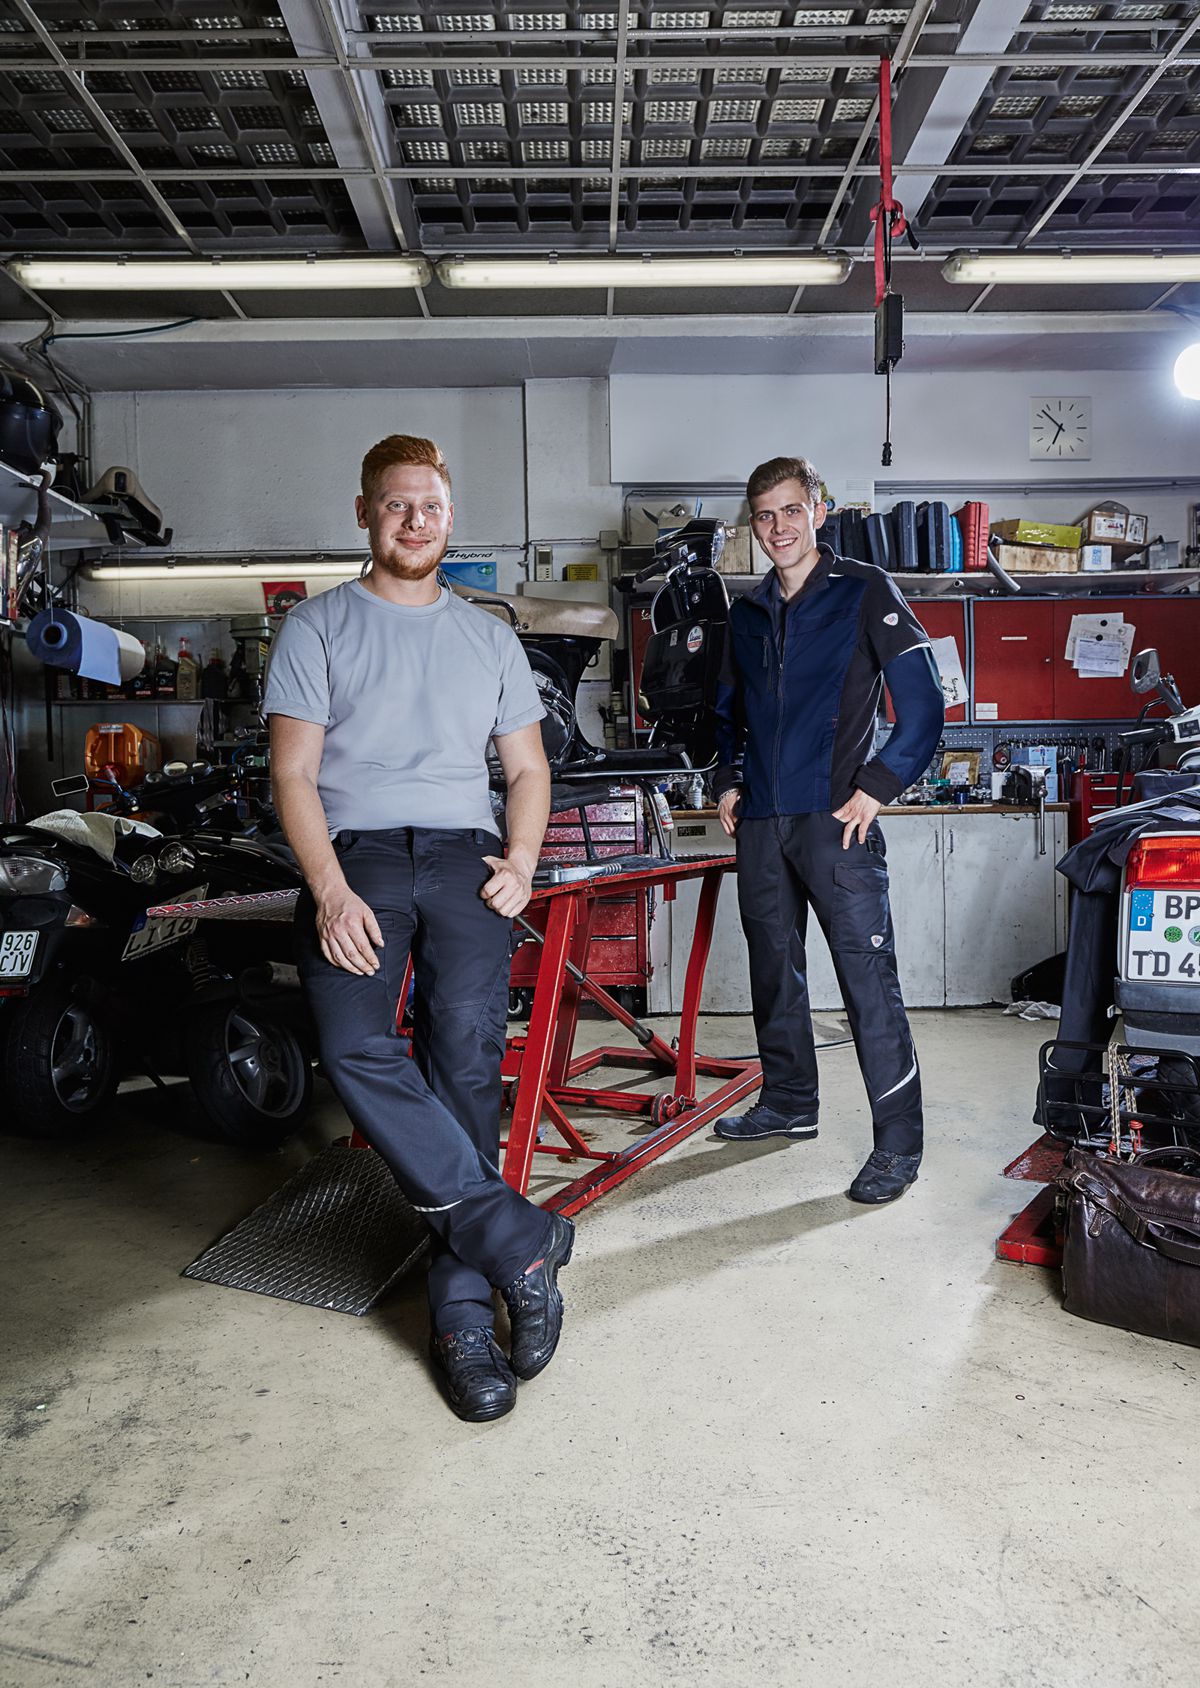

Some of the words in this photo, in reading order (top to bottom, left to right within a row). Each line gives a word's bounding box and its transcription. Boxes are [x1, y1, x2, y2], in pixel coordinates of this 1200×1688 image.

[455, 552, 493, 560] Hybrid
[1137, 916, 1147, 926] D
[4, 933, 34, 951] 926
[0, 953, 30, 973] CJV
[1132, 950, 1170, 977] TD
[1178, 952, 1200, 978] 4
